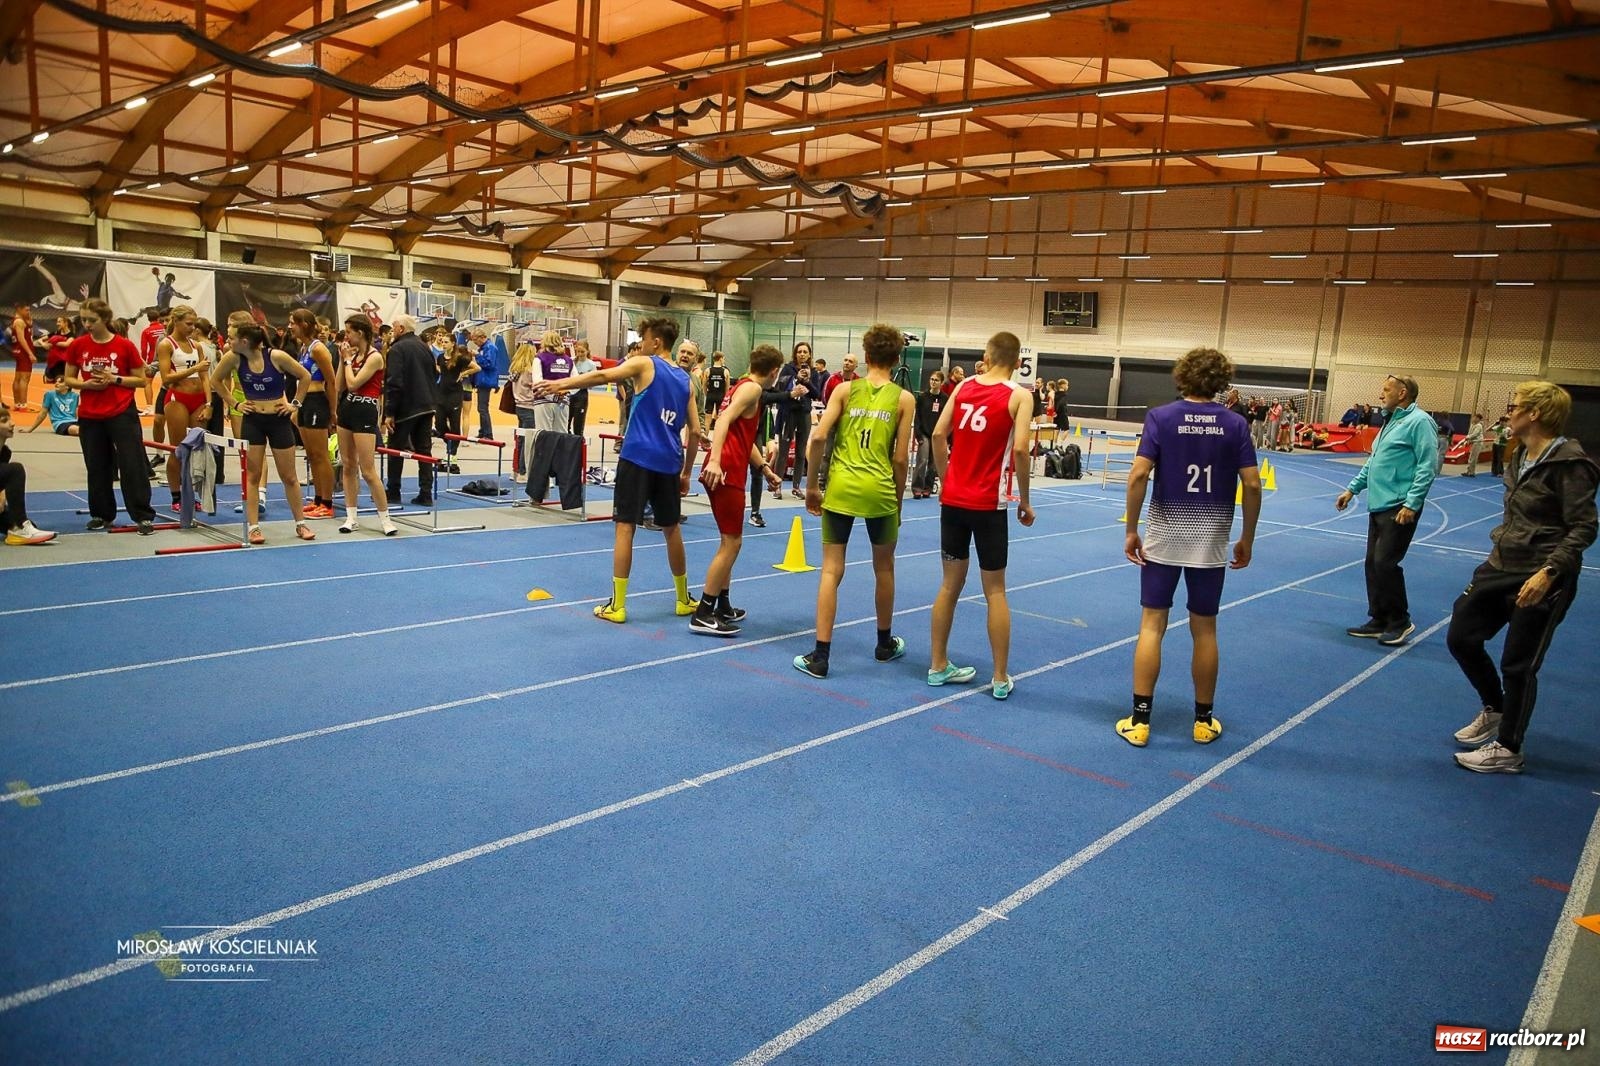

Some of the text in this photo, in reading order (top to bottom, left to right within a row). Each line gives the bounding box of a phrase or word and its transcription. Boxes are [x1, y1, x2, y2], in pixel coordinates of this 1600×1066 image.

[1019, 357, 1032, 377] 5
[958, 402, 989, 433] 76
[1184, 414, 1217, 424] KS SPRINT
[860, 428, 872, 449] 11
[1186, 463, 1213, 493] 21
